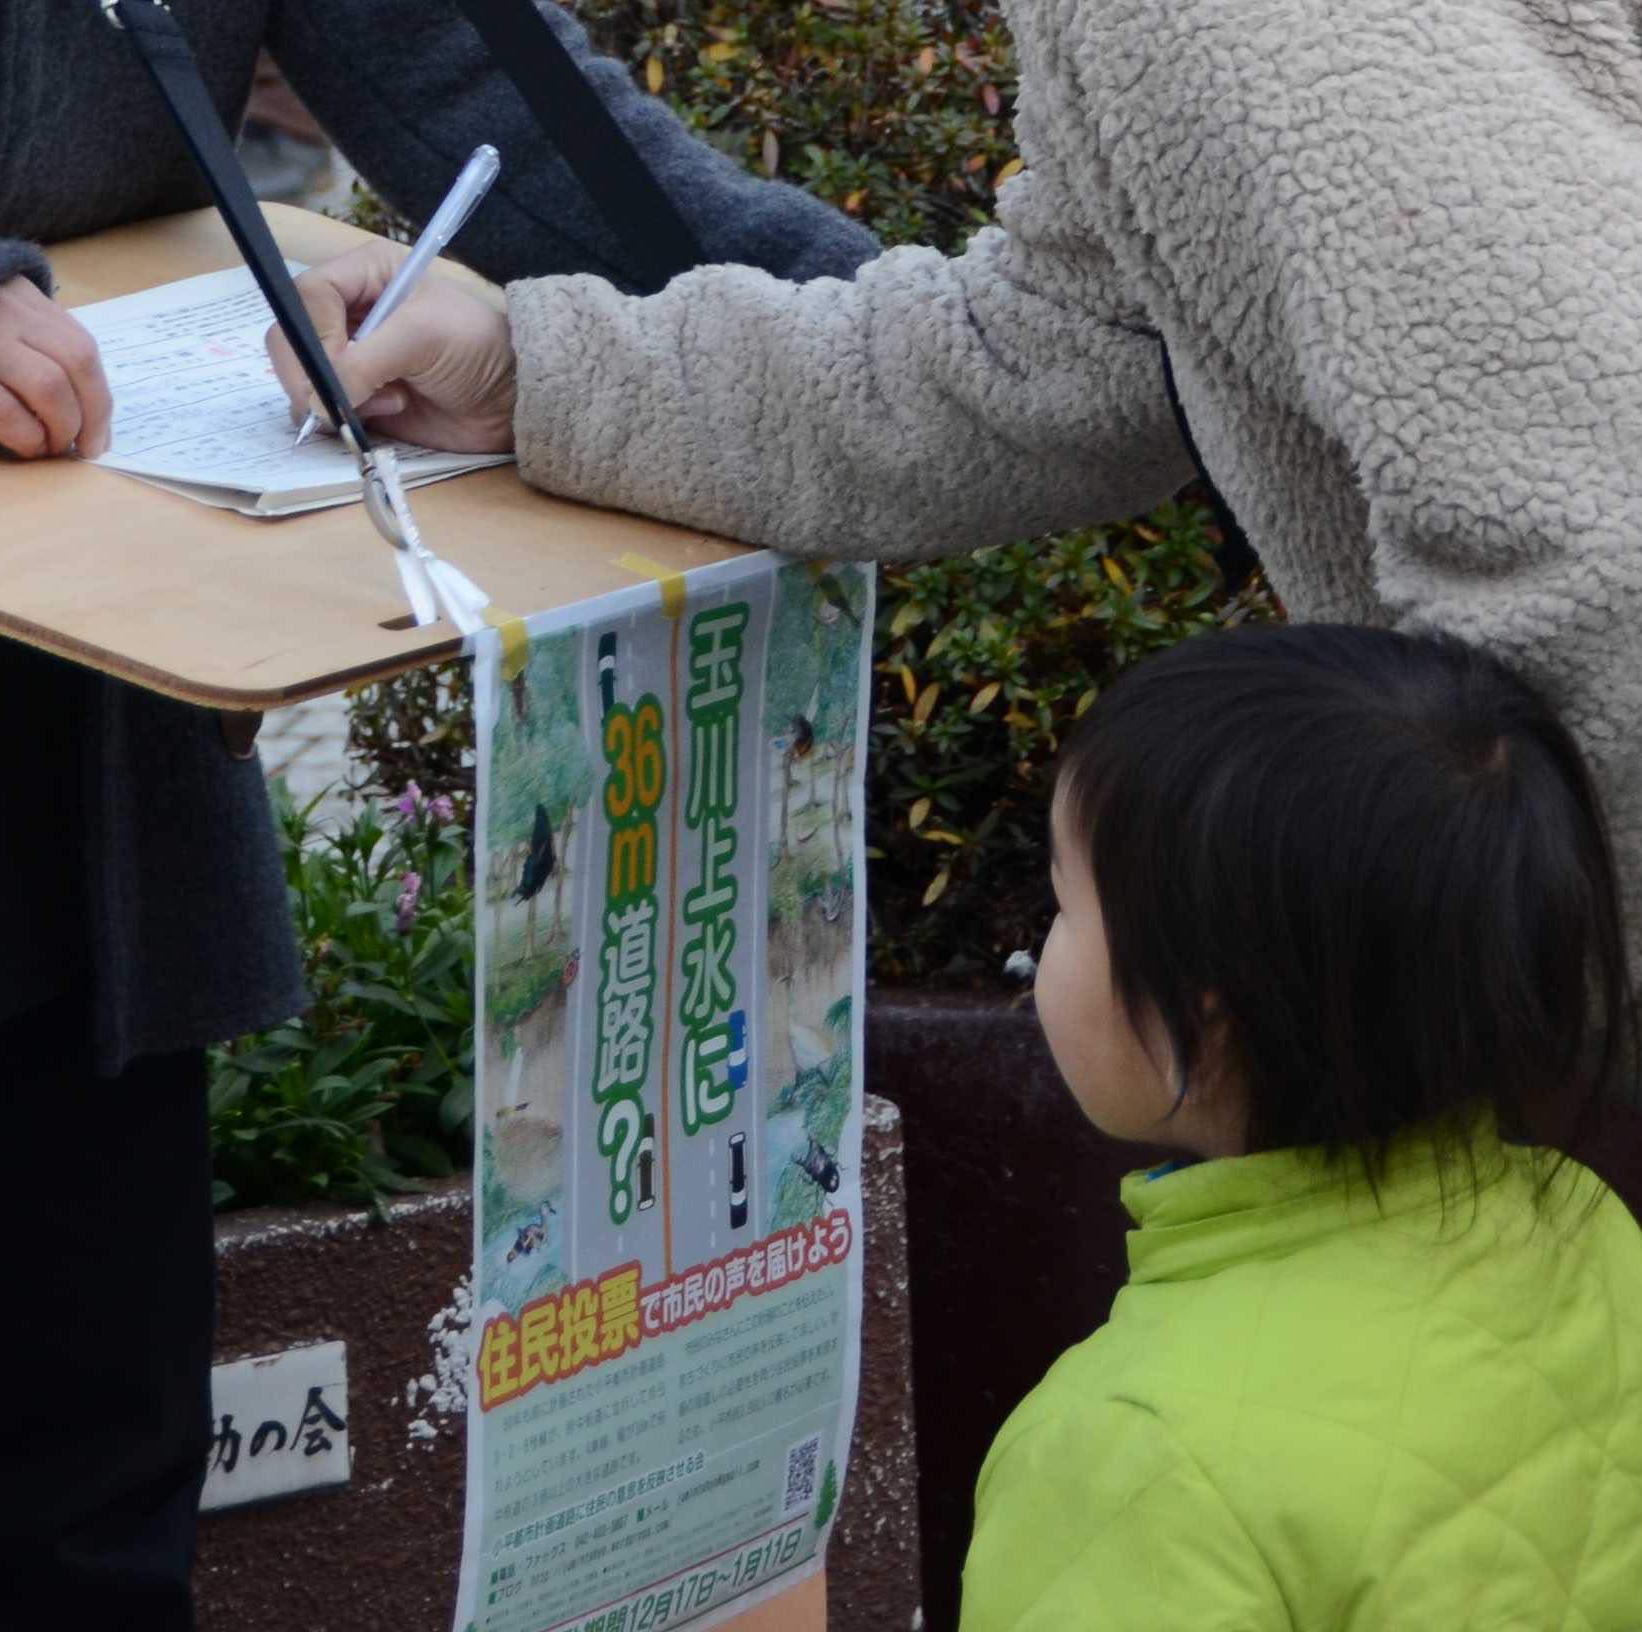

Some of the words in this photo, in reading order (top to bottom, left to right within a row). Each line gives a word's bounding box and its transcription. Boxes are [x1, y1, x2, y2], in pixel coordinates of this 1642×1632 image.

[597, 703, 663, 1215] 36m道路?
[683, 612, 745, 1127] 玉川上水に
[480, 1214, 852, 1405] 住民投票で市民の声を届けよう
